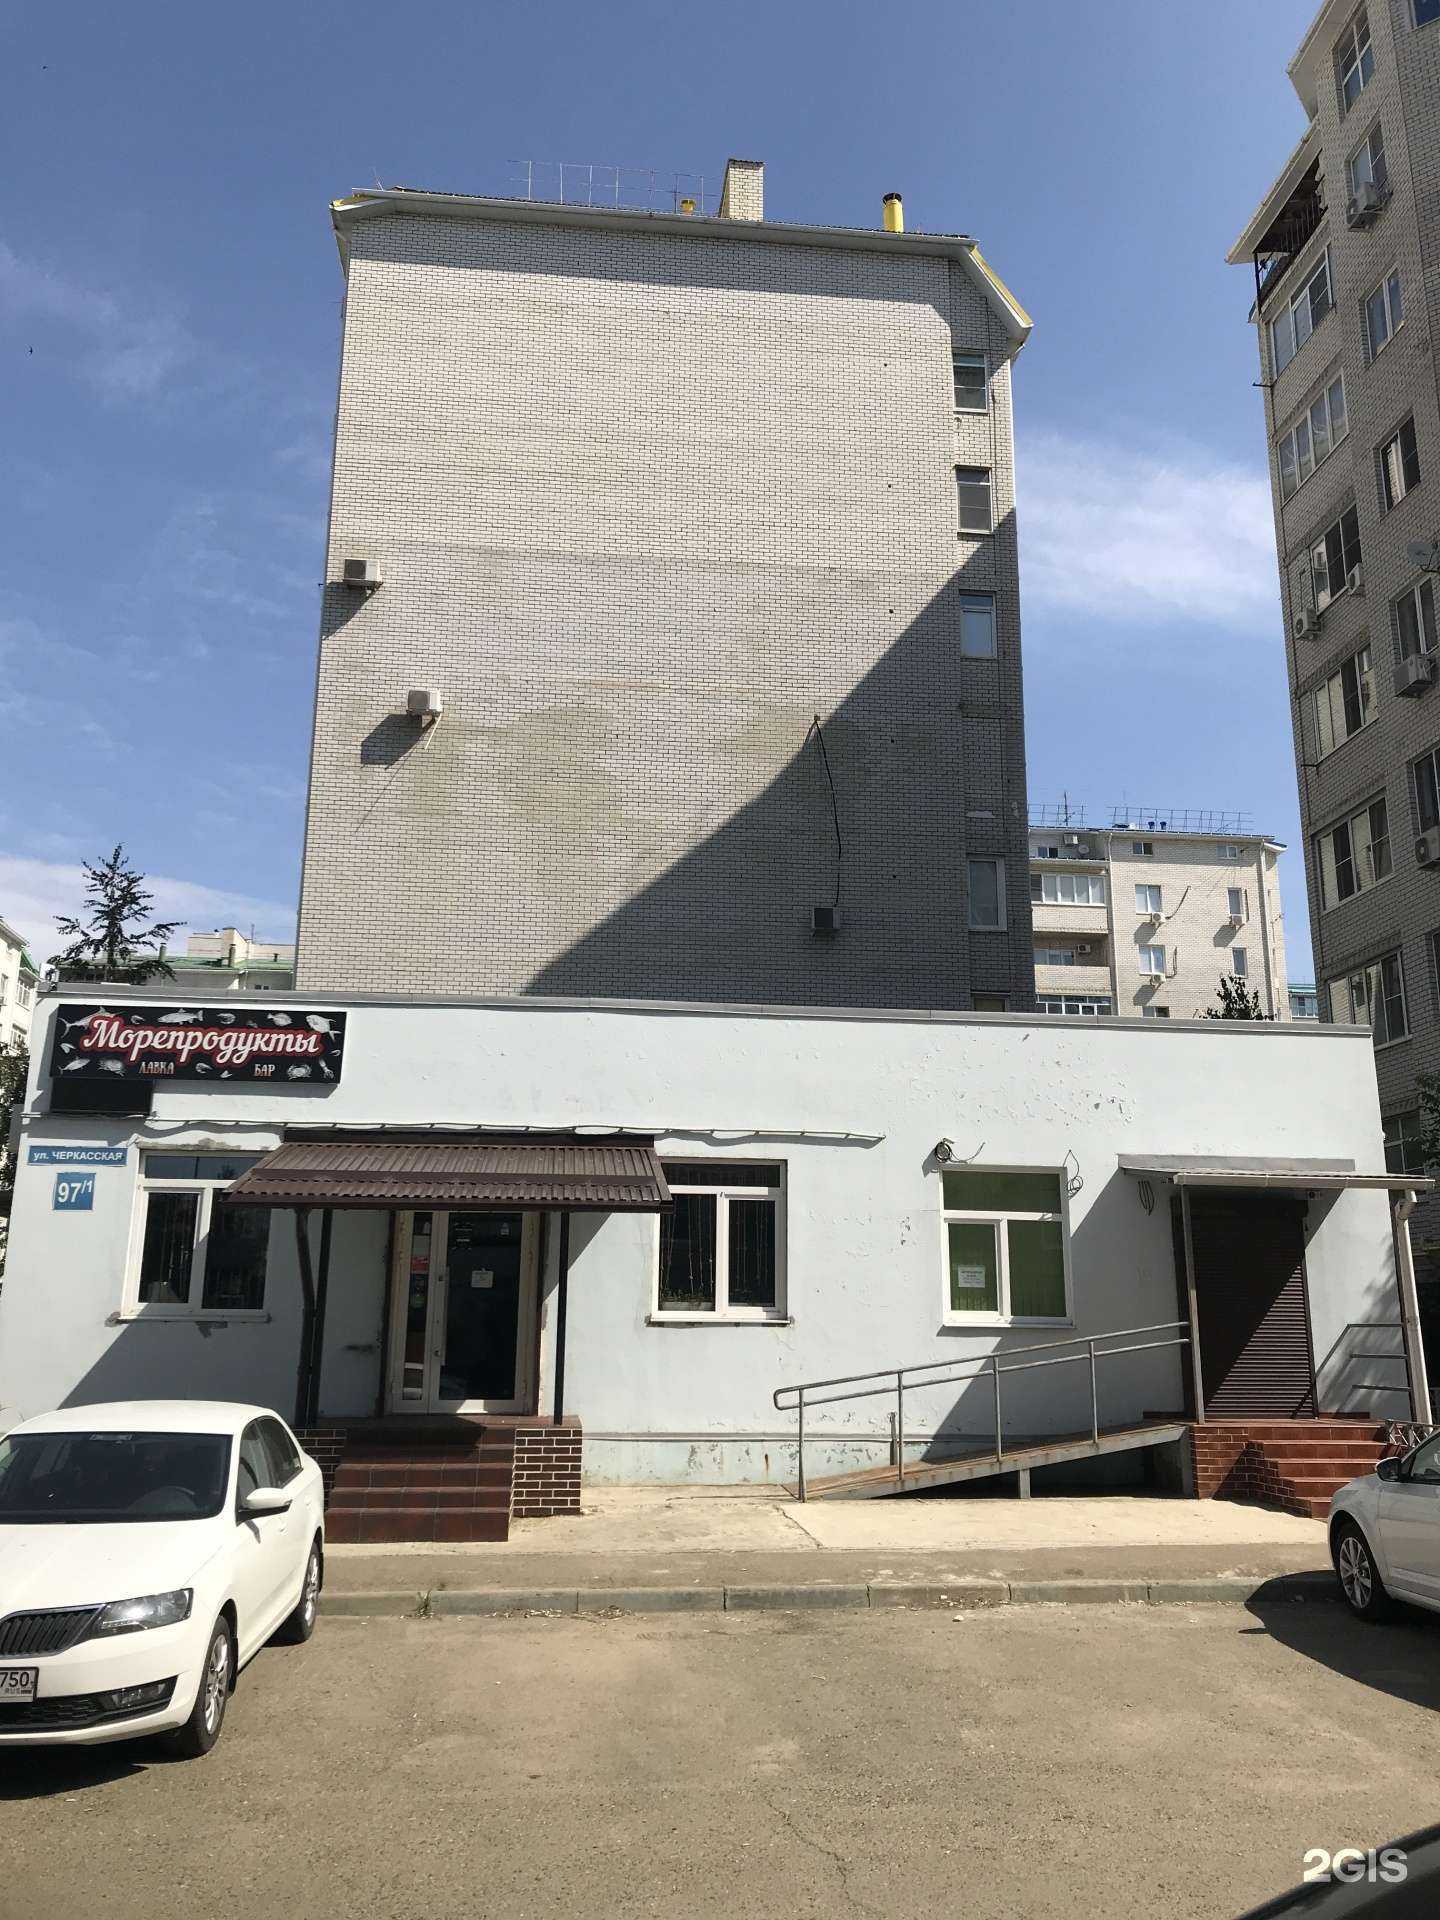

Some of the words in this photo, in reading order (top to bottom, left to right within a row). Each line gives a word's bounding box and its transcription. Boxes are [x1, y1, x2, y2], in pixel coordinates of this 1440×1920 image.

[83, 1019, 320, 1063] Морепродукты
[139, 1060, 175, 1075] ЛАВКА
[255, 1062, 276, 1078] БАР
[33, 1151, 49, 1161] ул.
[52, 1151, 123, 1160] ЧЕРКАССКАЯ
